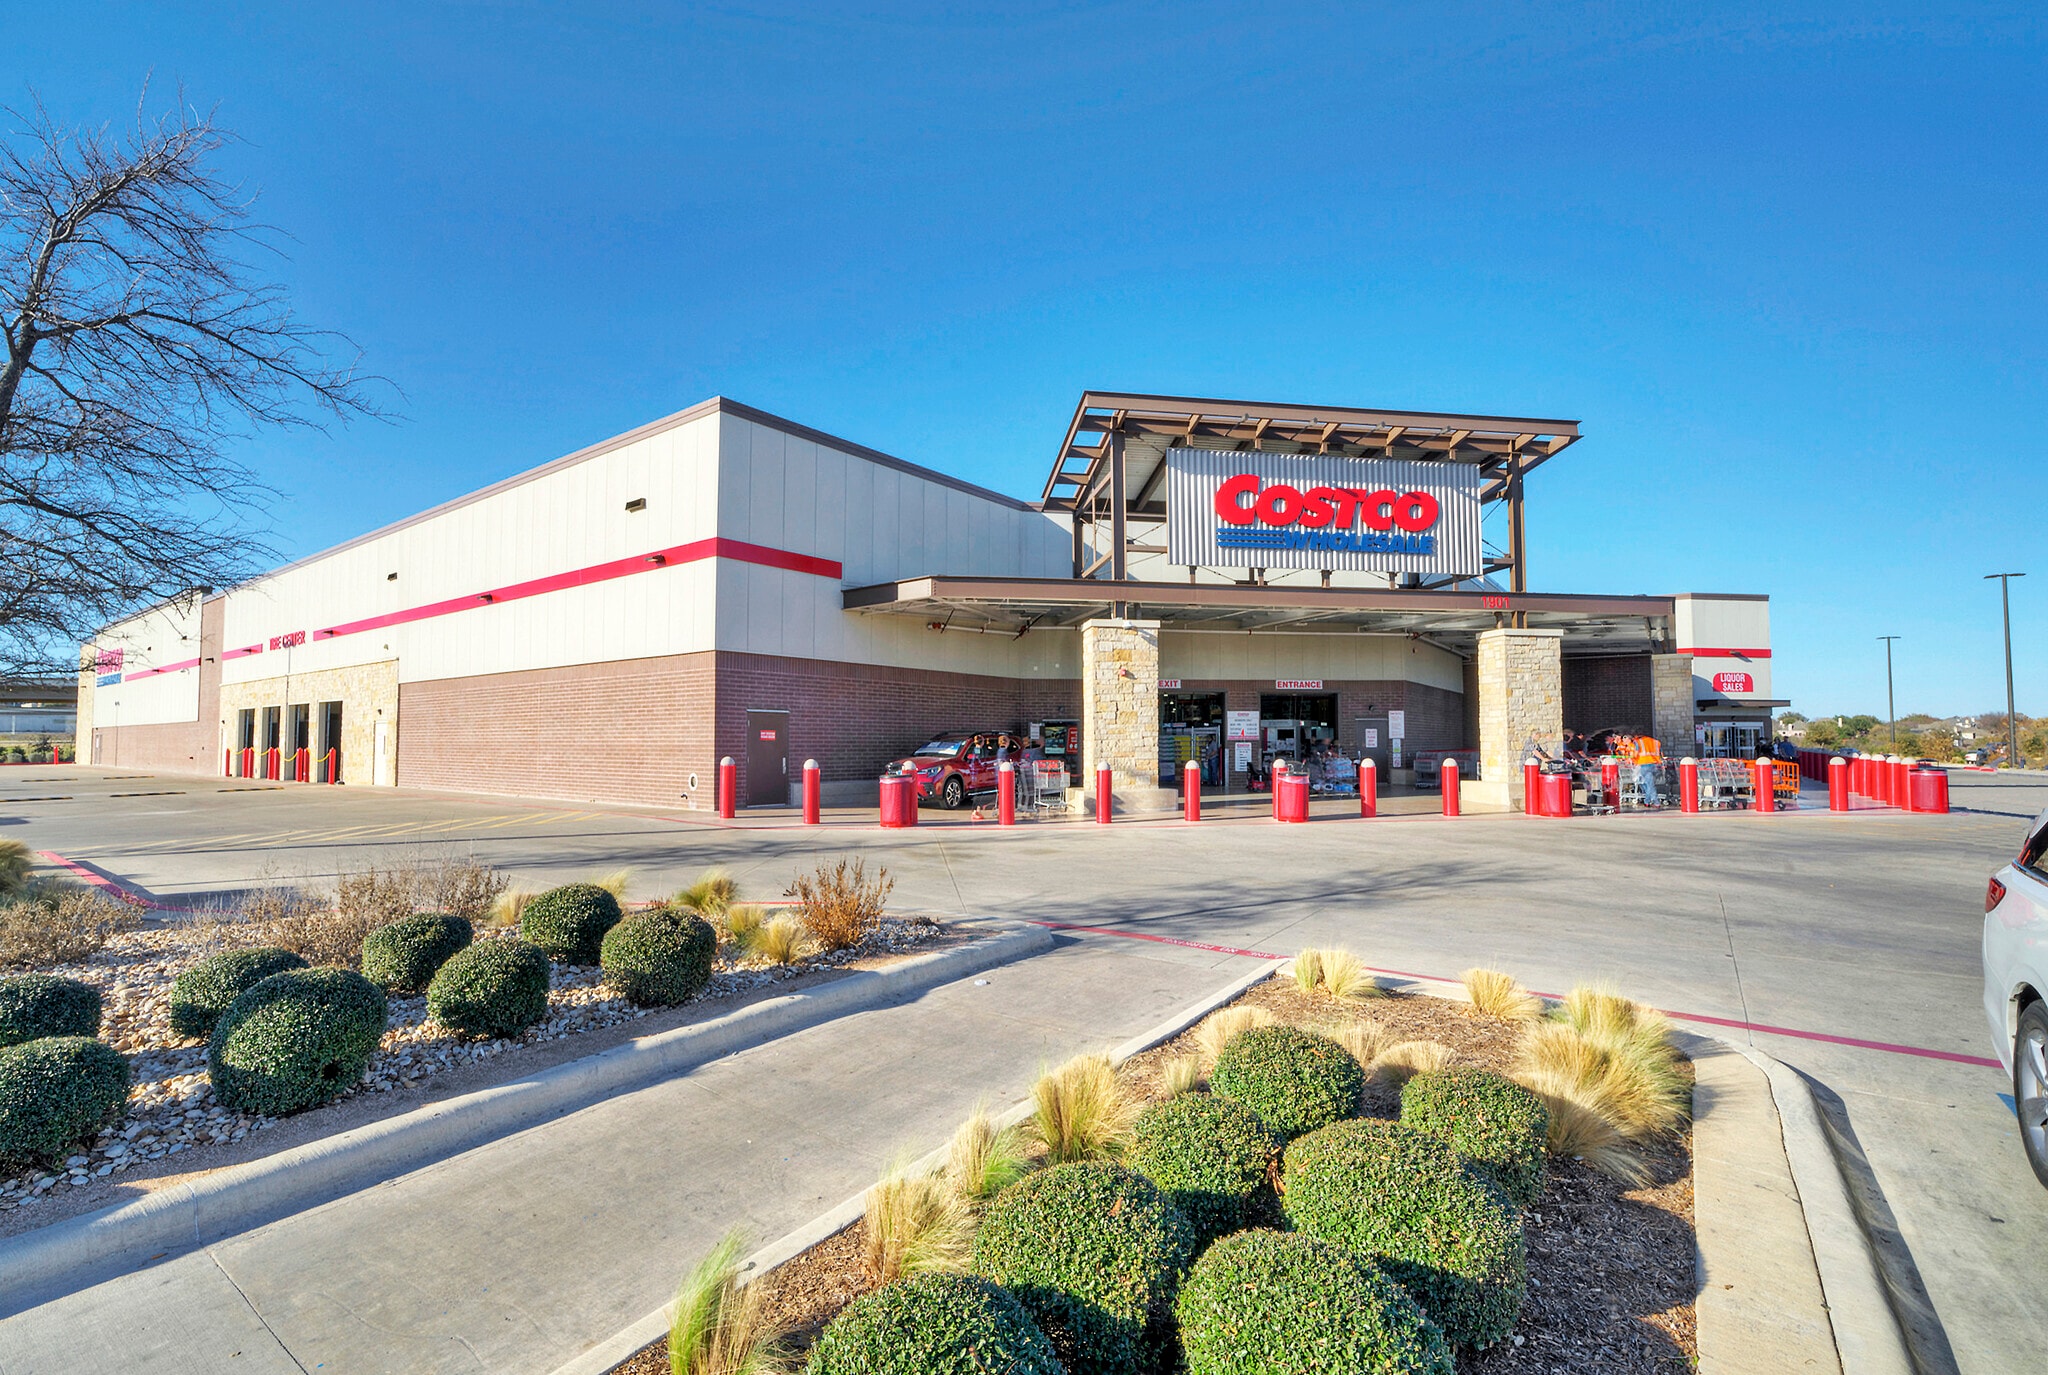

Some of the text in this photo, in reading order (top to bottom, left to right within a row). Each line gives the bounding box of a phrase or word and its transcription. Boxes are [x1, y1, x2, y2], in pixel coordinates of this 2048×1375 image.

[1215, 473, 1439, 532] COSTCO
[1283, 530, 1434, 554] WHOLESALE
[1481, 595, 1510, 608] 1901
[1720, 673, 1746, 683] LIQUOR
[1158, 680, 1178, 688] EXIT
[1277, 681, 1321, 689] ENTRANCE
[1722, 682, 1744, 691] SALES
